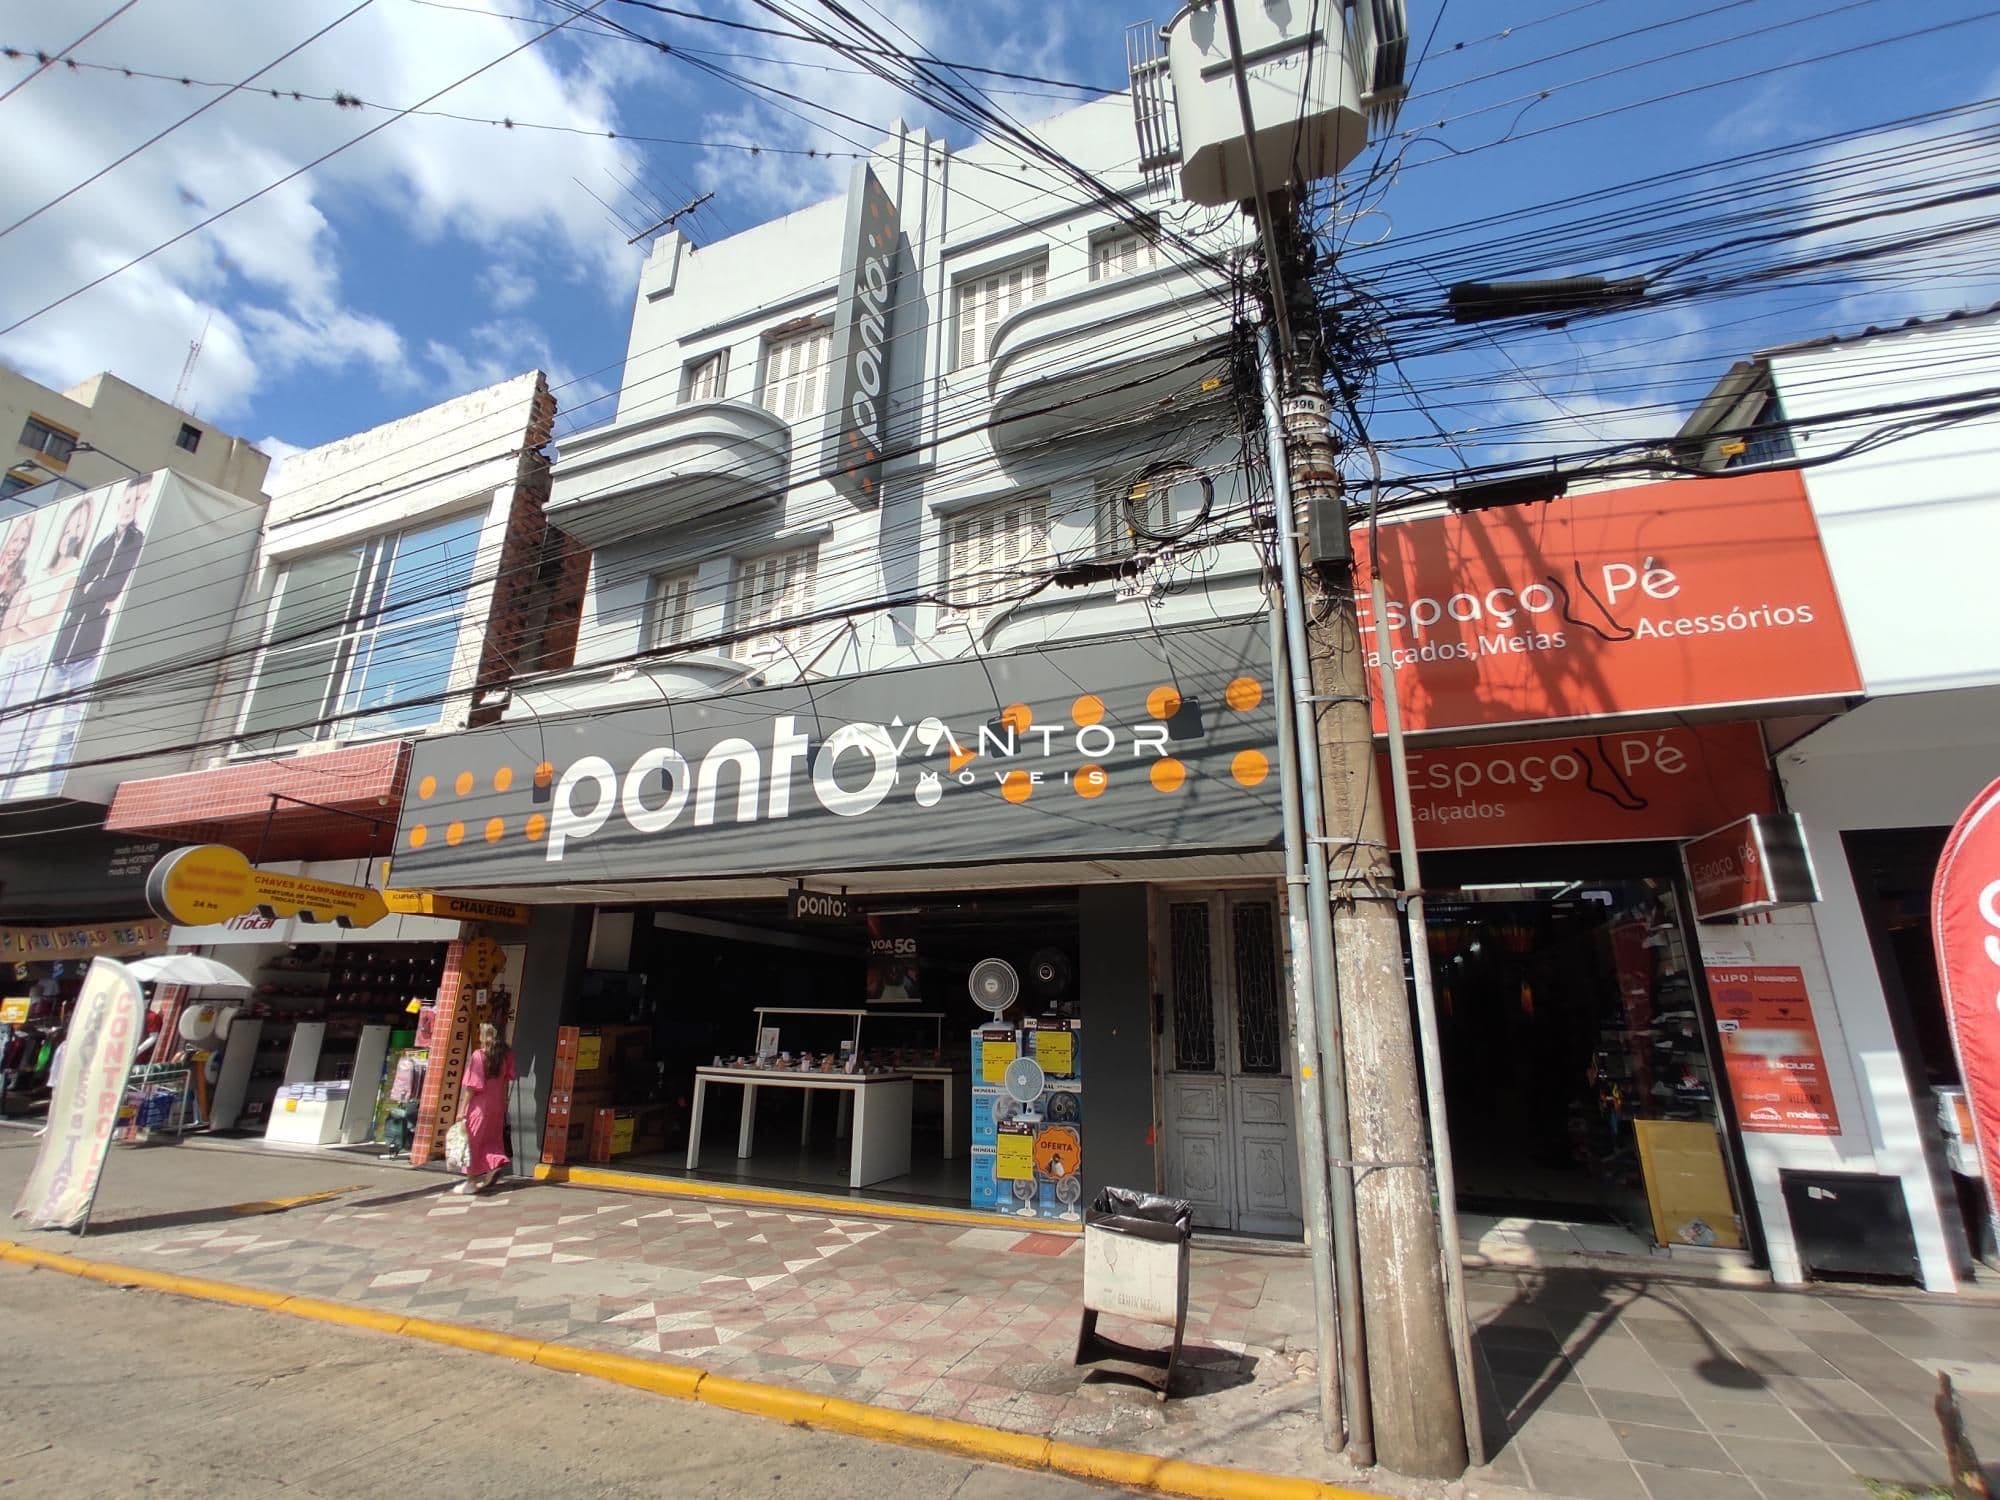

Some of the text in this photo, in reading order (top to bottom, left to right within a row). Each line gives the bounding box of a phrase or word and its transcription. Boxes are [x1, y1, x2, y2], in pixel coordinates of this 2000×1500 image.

[1602, 556, 1681, 605] Pé
[1635, 603, 1814, 640] Acessórios
[1620, 735, 1688, 777] Pé
[893, 768, 1106, 785] IMÓVEIS
[254, 876, 295, 890] CHAVES
[450, 899, 516, 918] CHAVEIRO
[871, 937, 917, 953] VOA 5G
[1712, 974, 1748, 983] LUPO
[1040, 1140, 1073, 1152] OFERTA
